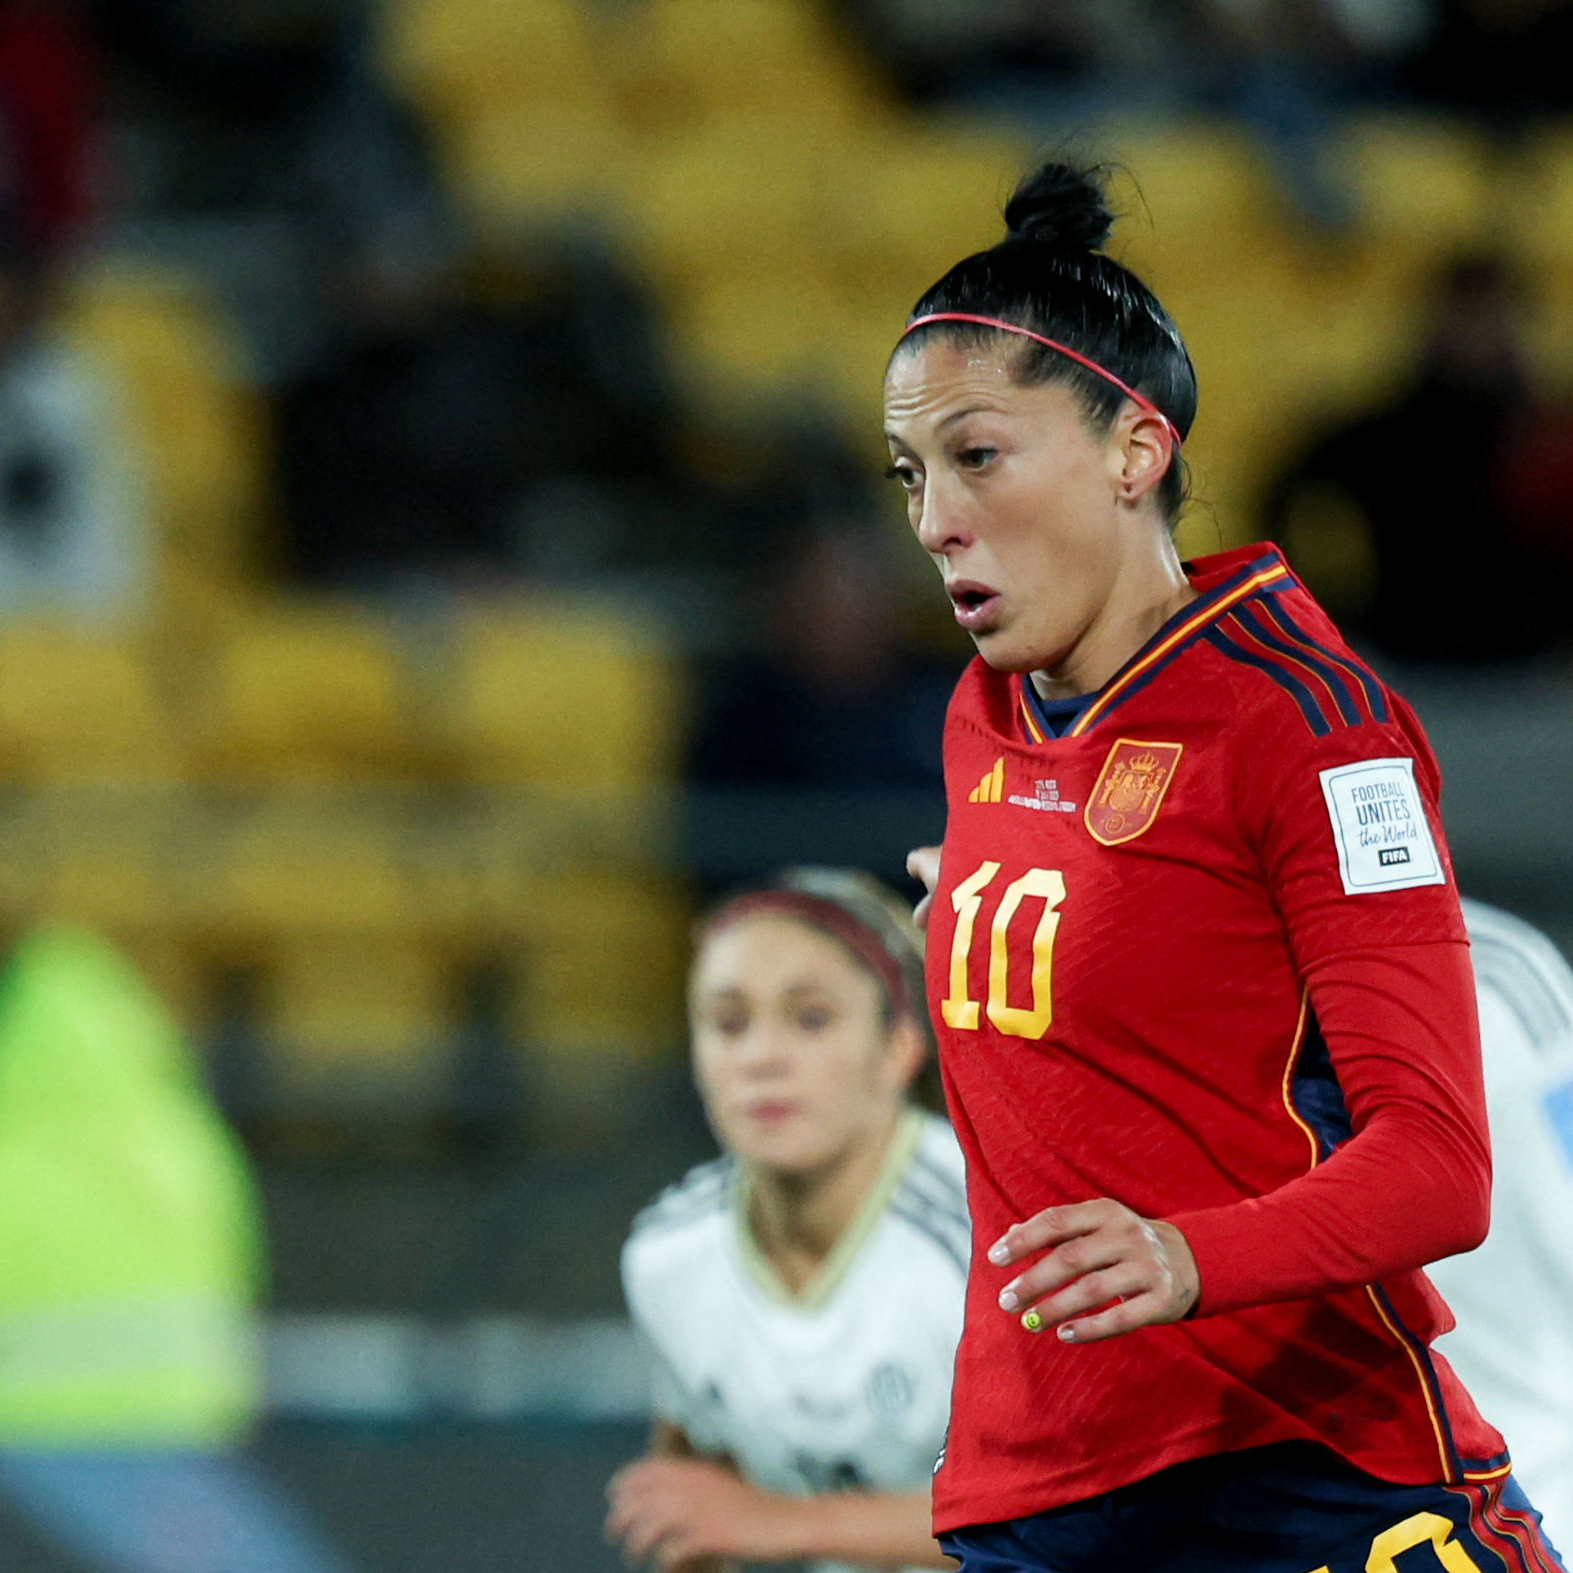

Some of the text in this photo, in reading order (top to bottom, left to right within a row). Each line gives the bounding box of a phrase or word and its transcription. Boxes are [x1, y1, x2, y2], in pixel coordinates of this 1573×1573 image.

[1351, 782, 1405, 803] FOOTBALL
[1356, 799, 1410, 826] UNITES
[1358, 822, 1418, 847] the World
[1381, 848, 1408, 865] FIFA
[941, 860, 1067, 1040] 10
